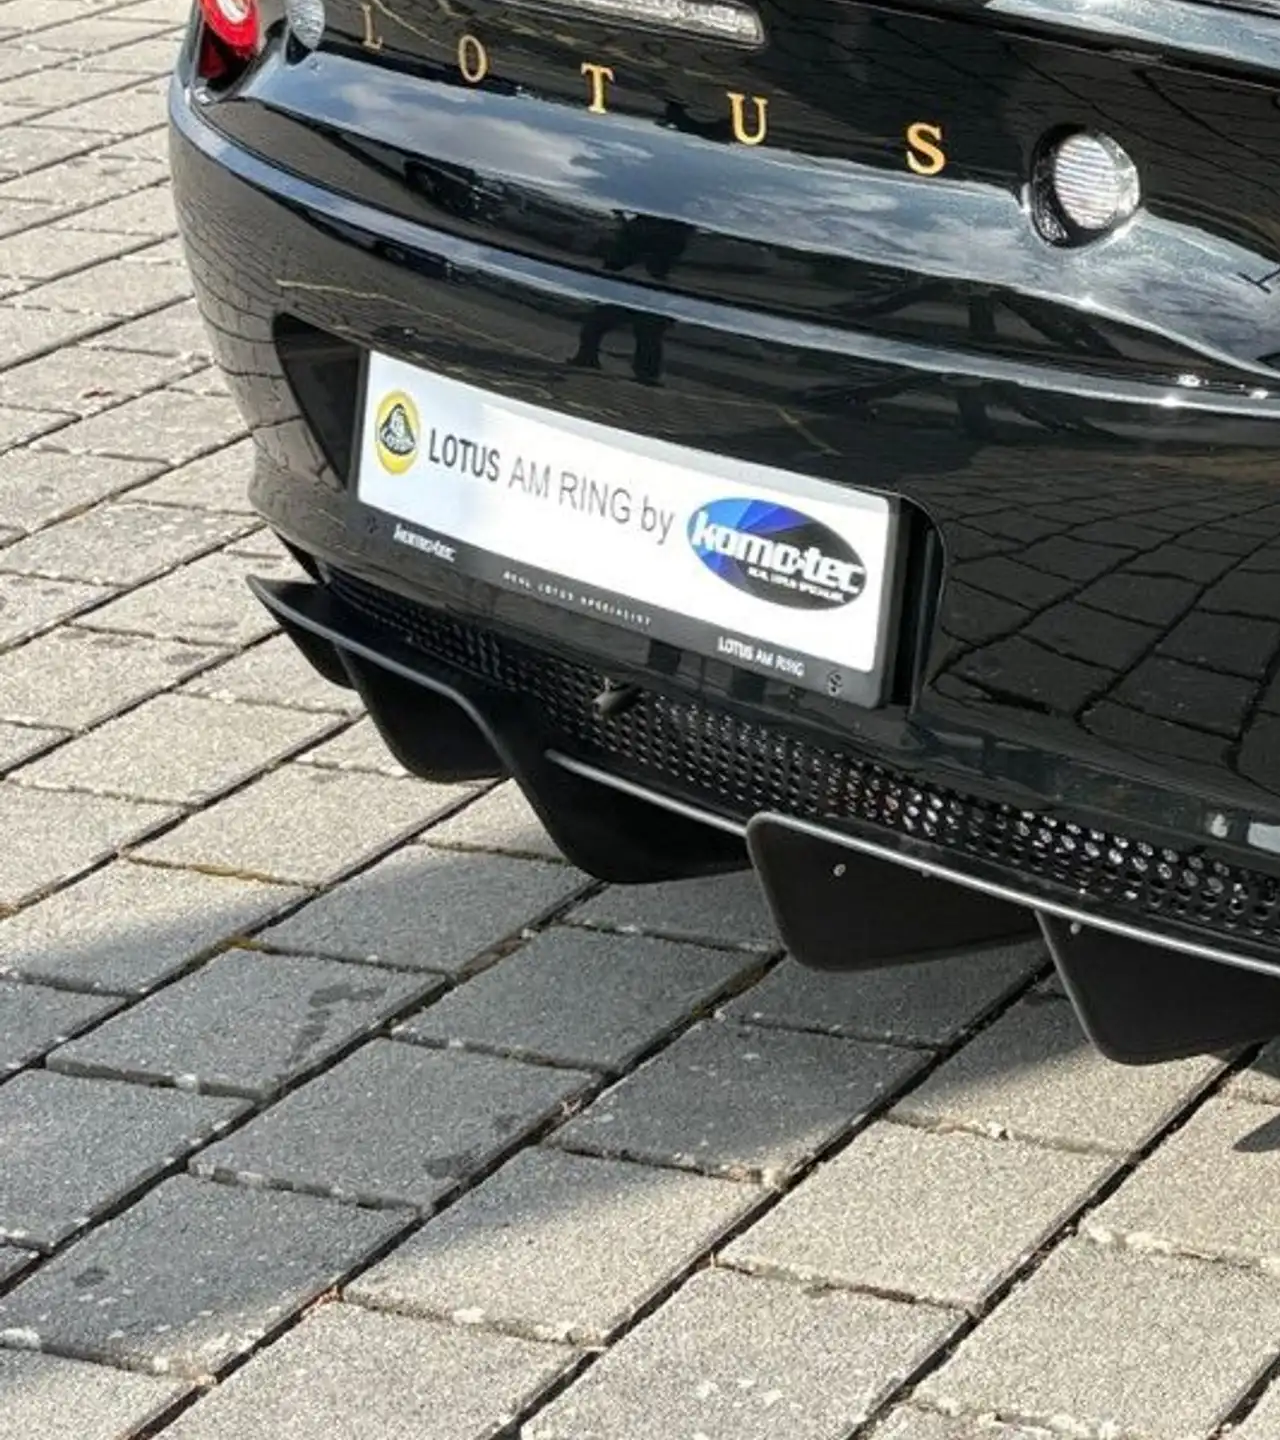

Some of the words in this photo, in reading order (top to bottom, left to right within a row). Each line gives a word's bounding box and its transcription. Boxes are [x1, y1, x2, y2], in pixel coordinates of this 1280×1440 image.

[361, 1, 947, 176] LOTUS
[428, 427, 501, 482] LOTUS
[508, 456, 551, 499] AM
[558, 471, 631, 524] RING
[640, 495, 675, 545] by
[717, 636, 754, 661] LOTUS
[755, 648, 774, 667] AM
